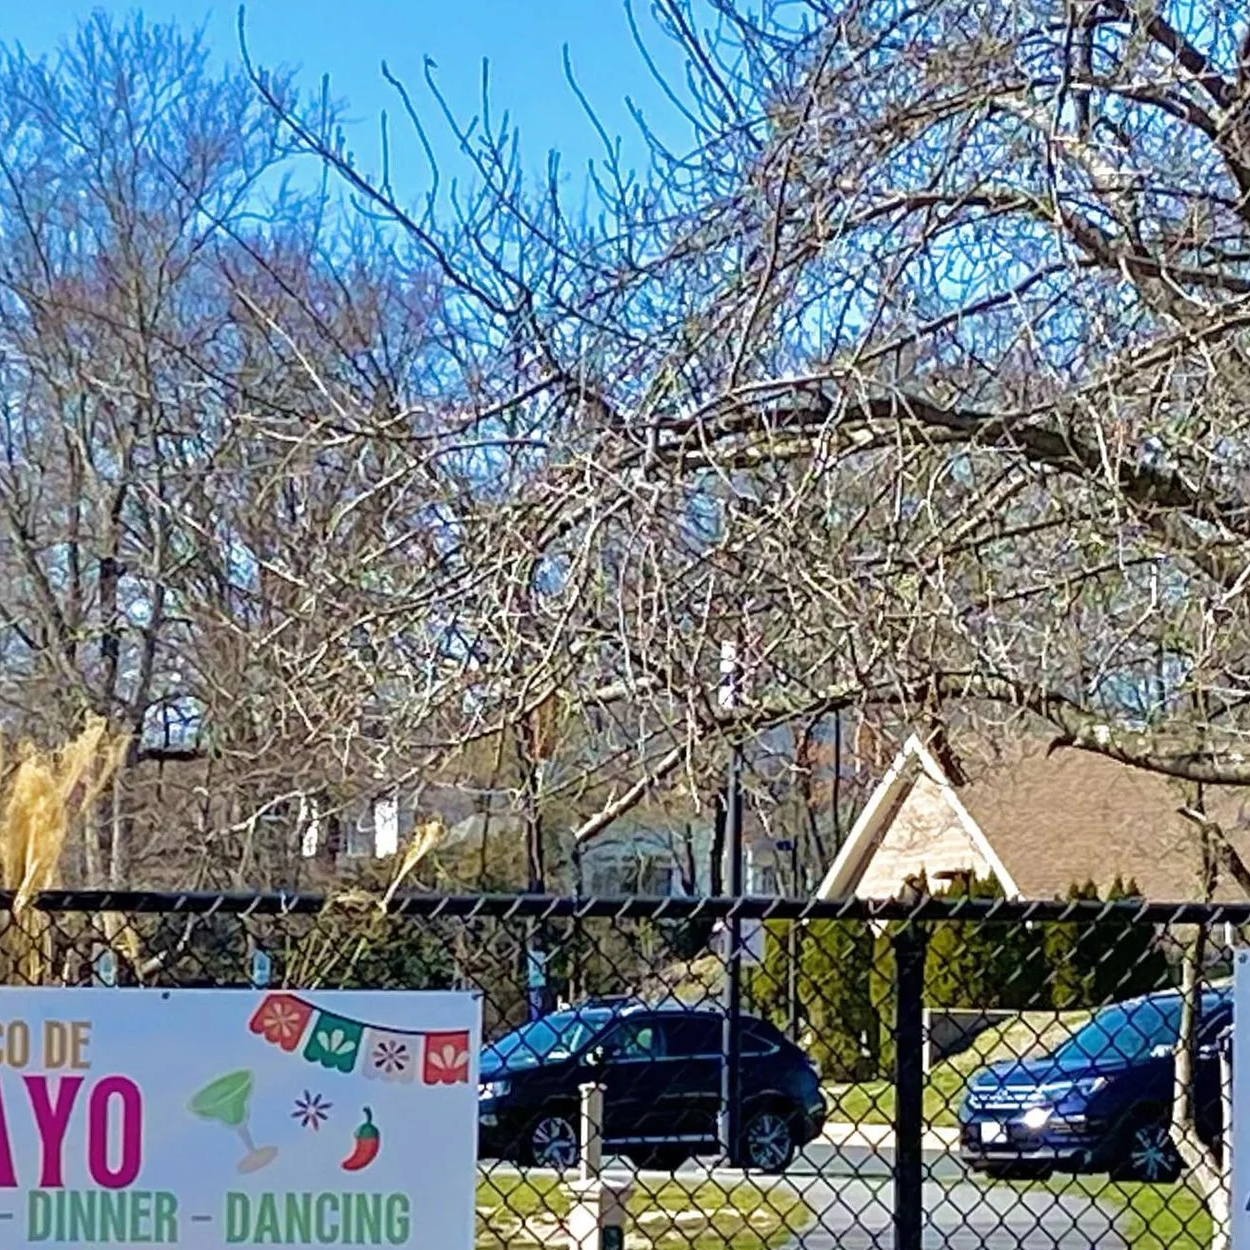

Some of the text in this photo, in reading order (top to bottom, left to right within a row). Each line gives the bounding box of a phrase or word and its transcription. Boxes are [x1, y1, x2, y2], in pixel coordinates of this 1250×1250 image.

[44, 1021, 92, 1069] DE
[28, 1191, 179, 1244] DINNER
[226, 1192, 410, 1245] DANCING
